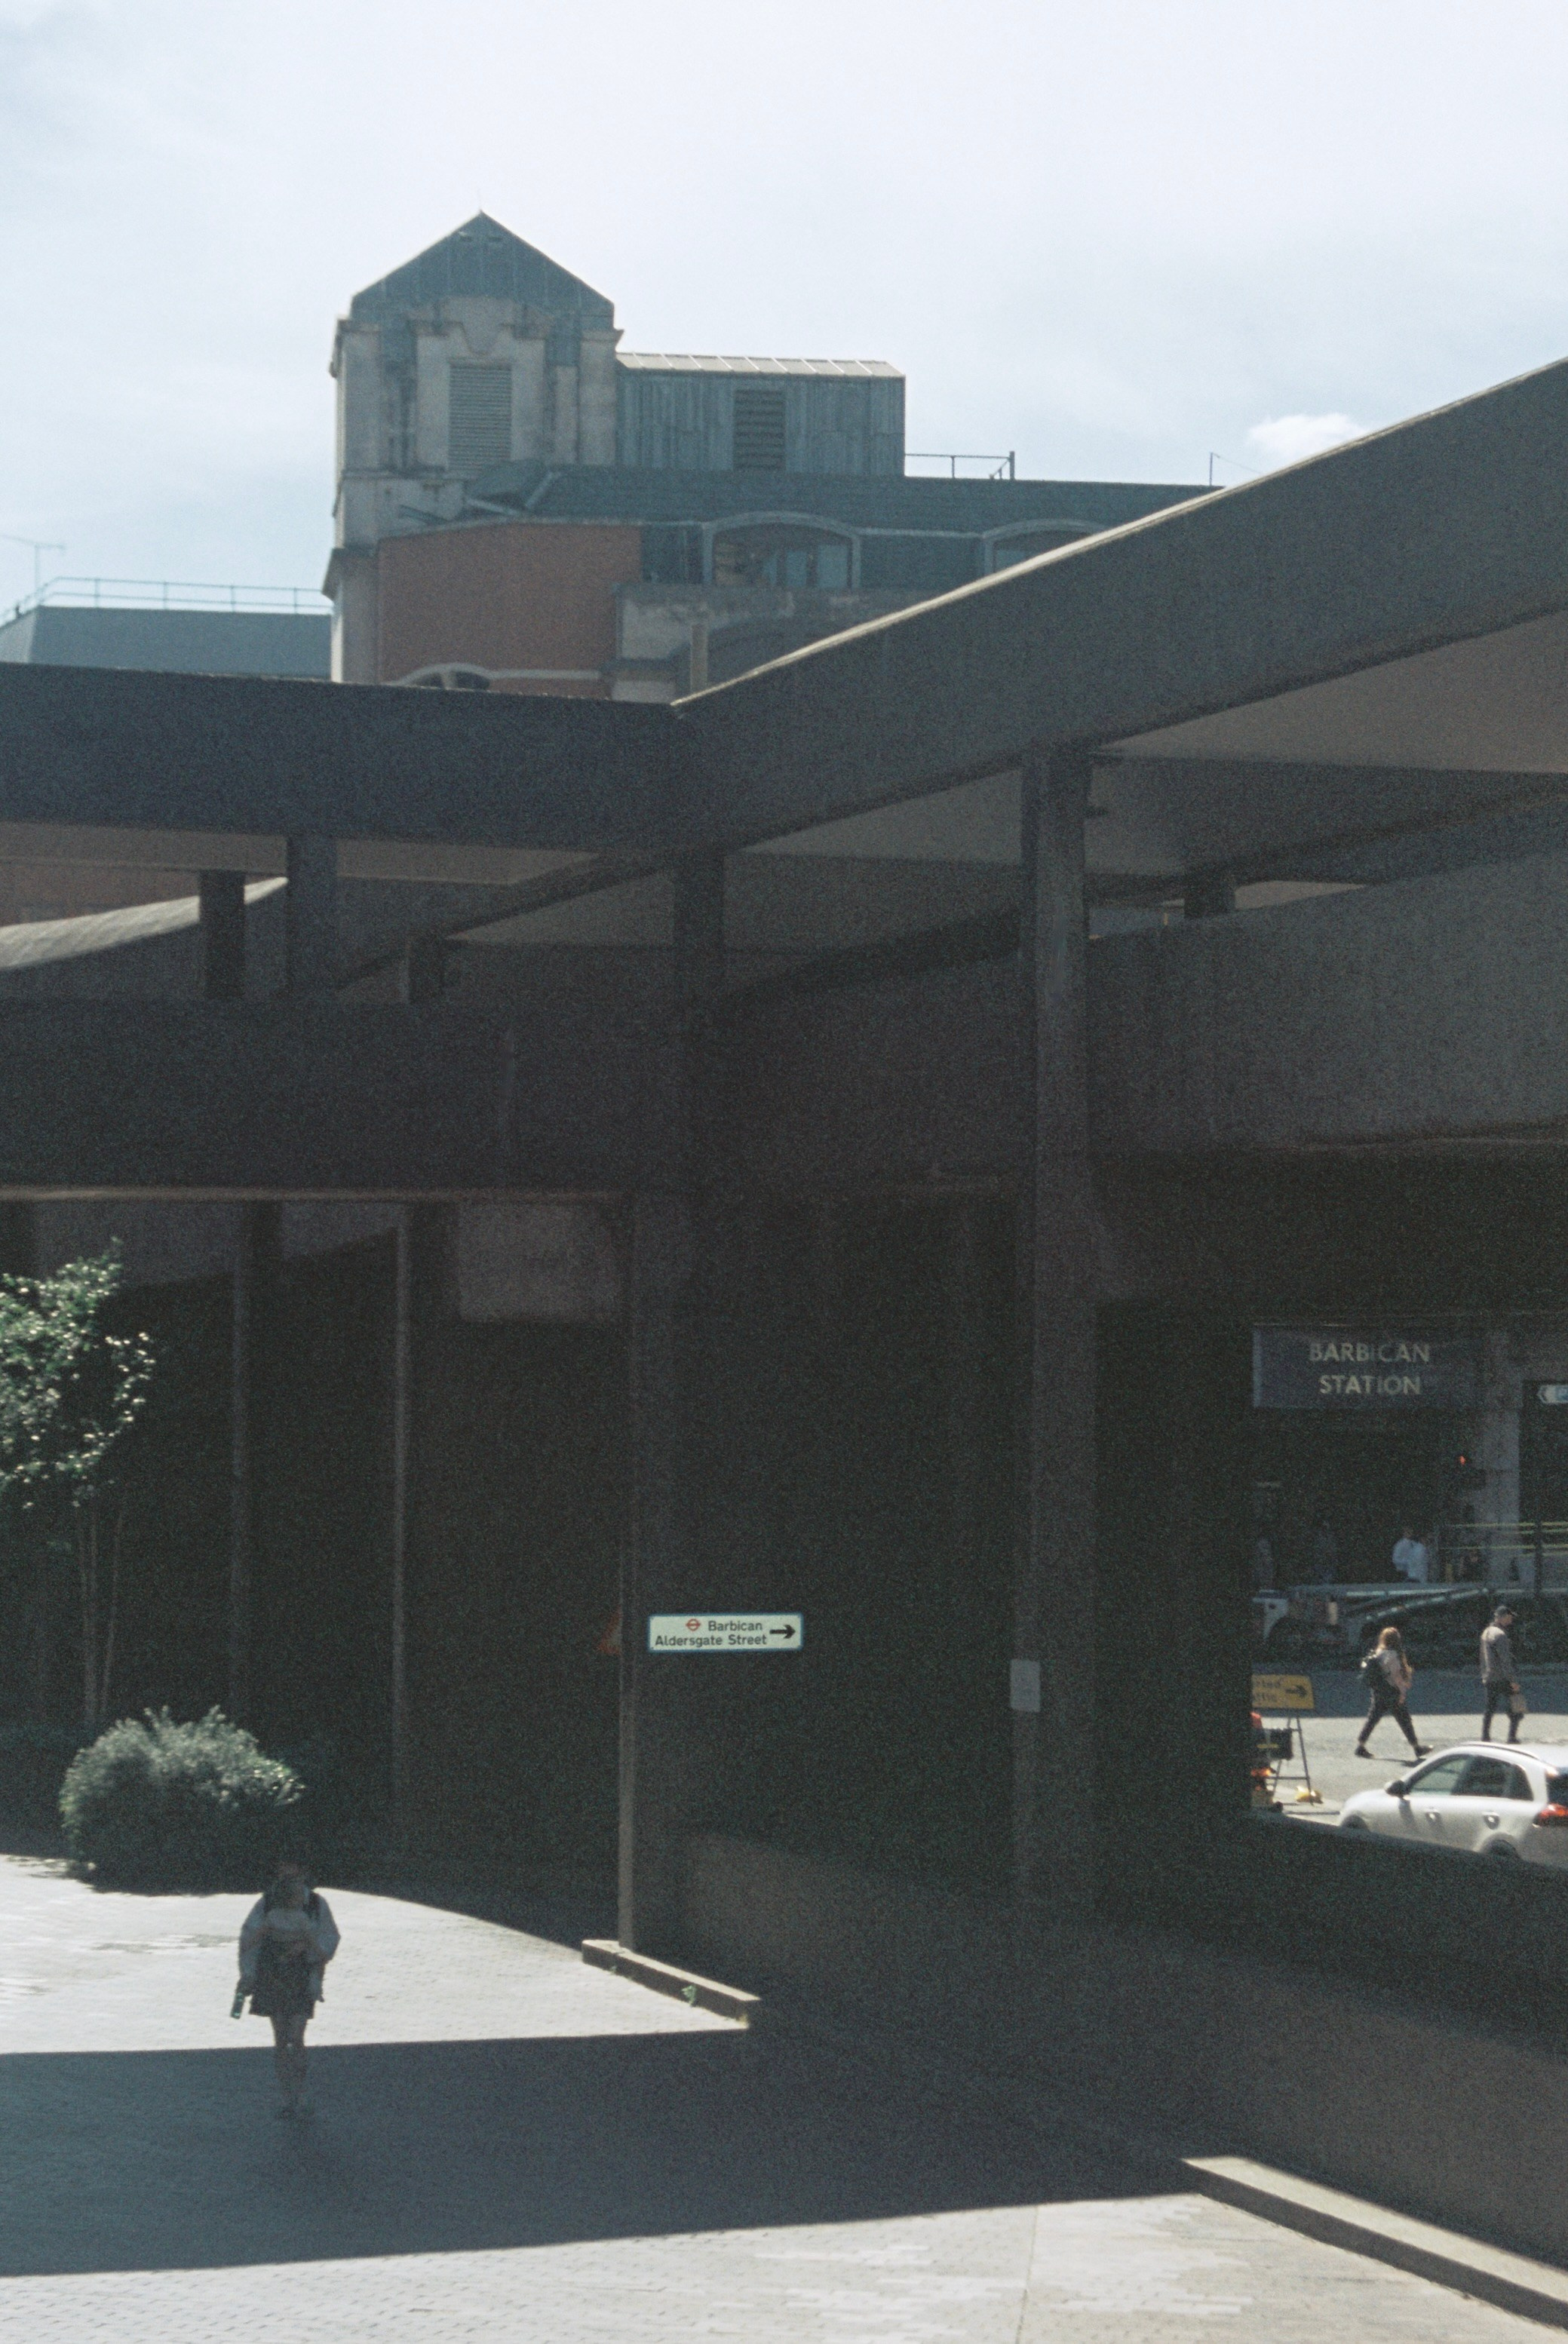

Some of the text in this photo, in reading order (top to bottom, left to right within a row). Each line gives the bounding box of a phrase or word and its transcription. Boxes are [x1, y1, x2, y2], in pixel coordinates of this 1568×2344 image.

[1309, 1342, 1430, 1362] BARBICAN
[1319, 1375, 1421, 1394] STATION
[708, 1621, 763, 1631] Barbican
[655, 1634, 767, 1648] Aldersgate Street
